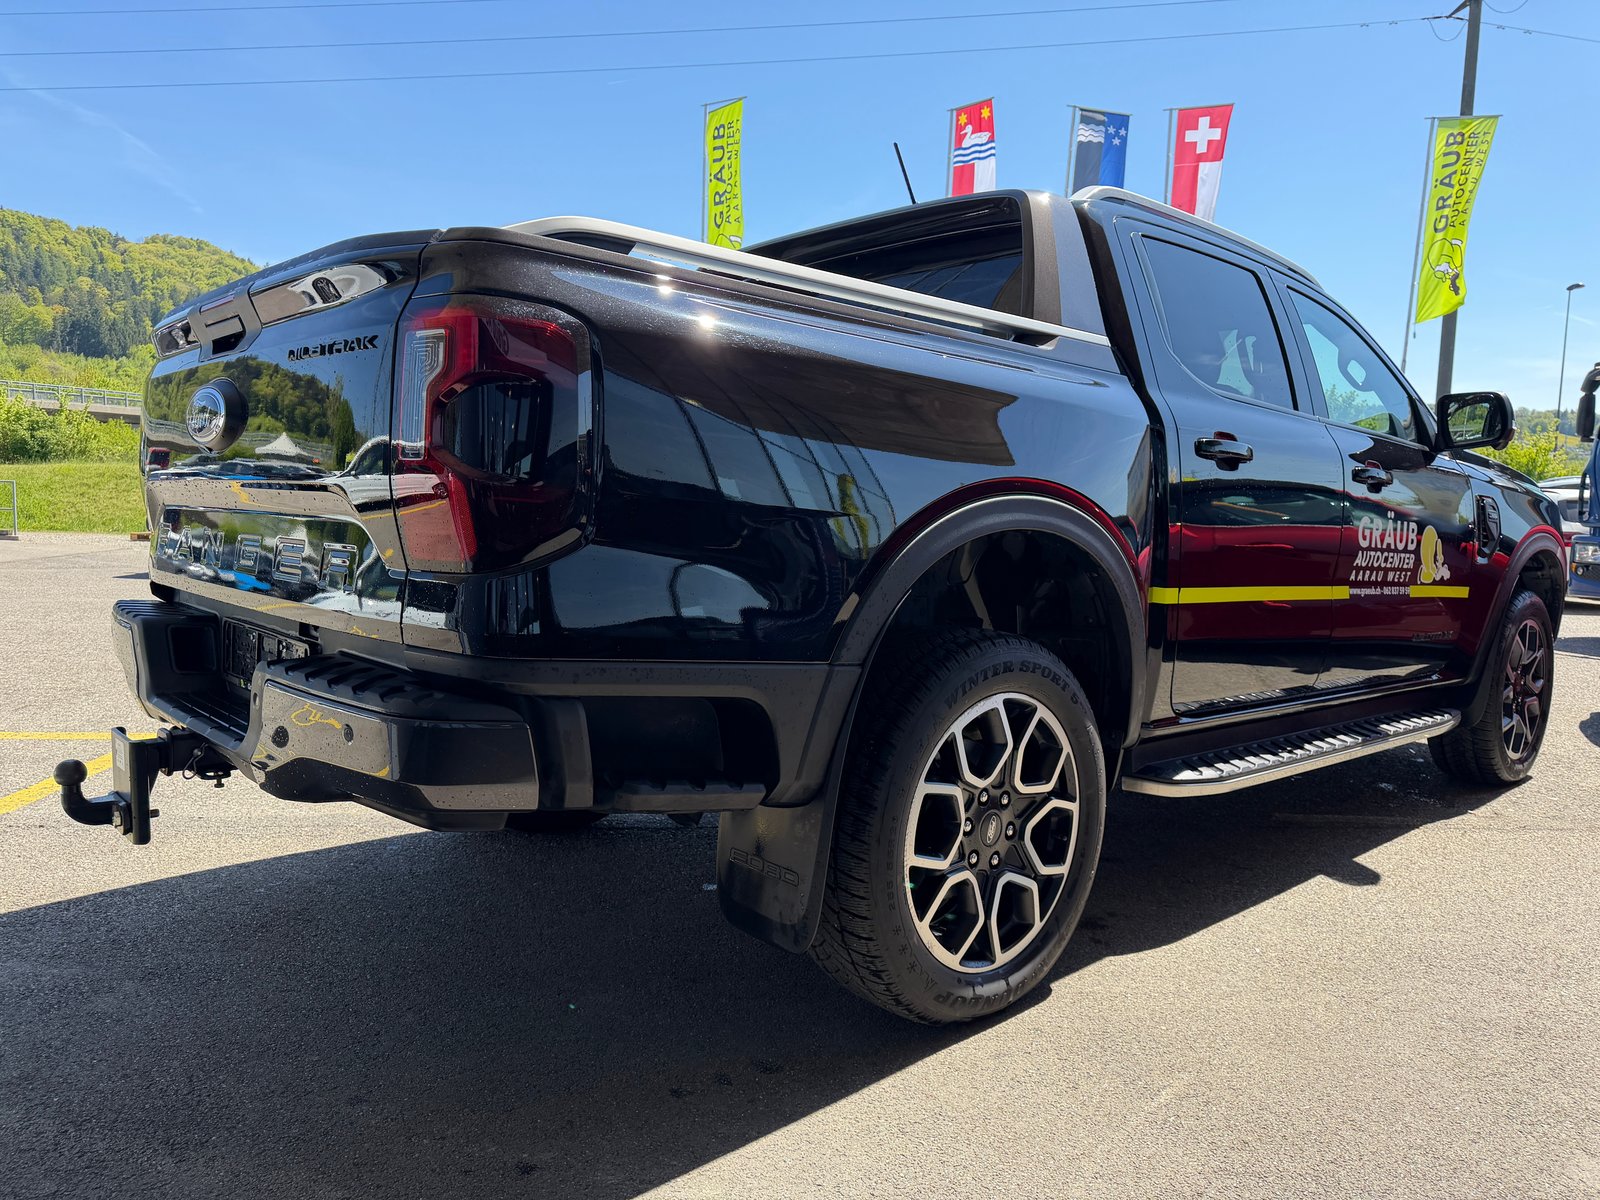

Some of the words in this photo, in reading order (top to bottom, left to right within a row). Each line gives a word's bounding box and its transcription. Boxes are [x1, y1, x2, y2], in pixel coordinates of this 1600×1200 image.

[724, 120, 735, 224] AUTOCENTER
[1475, 131, 1492, 168] WEST
[709, 123, 727, 229] GRÄUB
[1433, 131, 1466, 234] GRÄUB
[1449, 131, 1483, 228] AUTOCENTER
[1358, 511, 1418, 551] GRÄUB
[1349, 569, 1383, 582] AARAU
[1387, 571, 1411, 583] WEST
[1353, 550, 1415, 569] AUTOCENTER
[944, 660, 1015, 709] WINTER
[1018, 659, 1071, 693] SPORT
